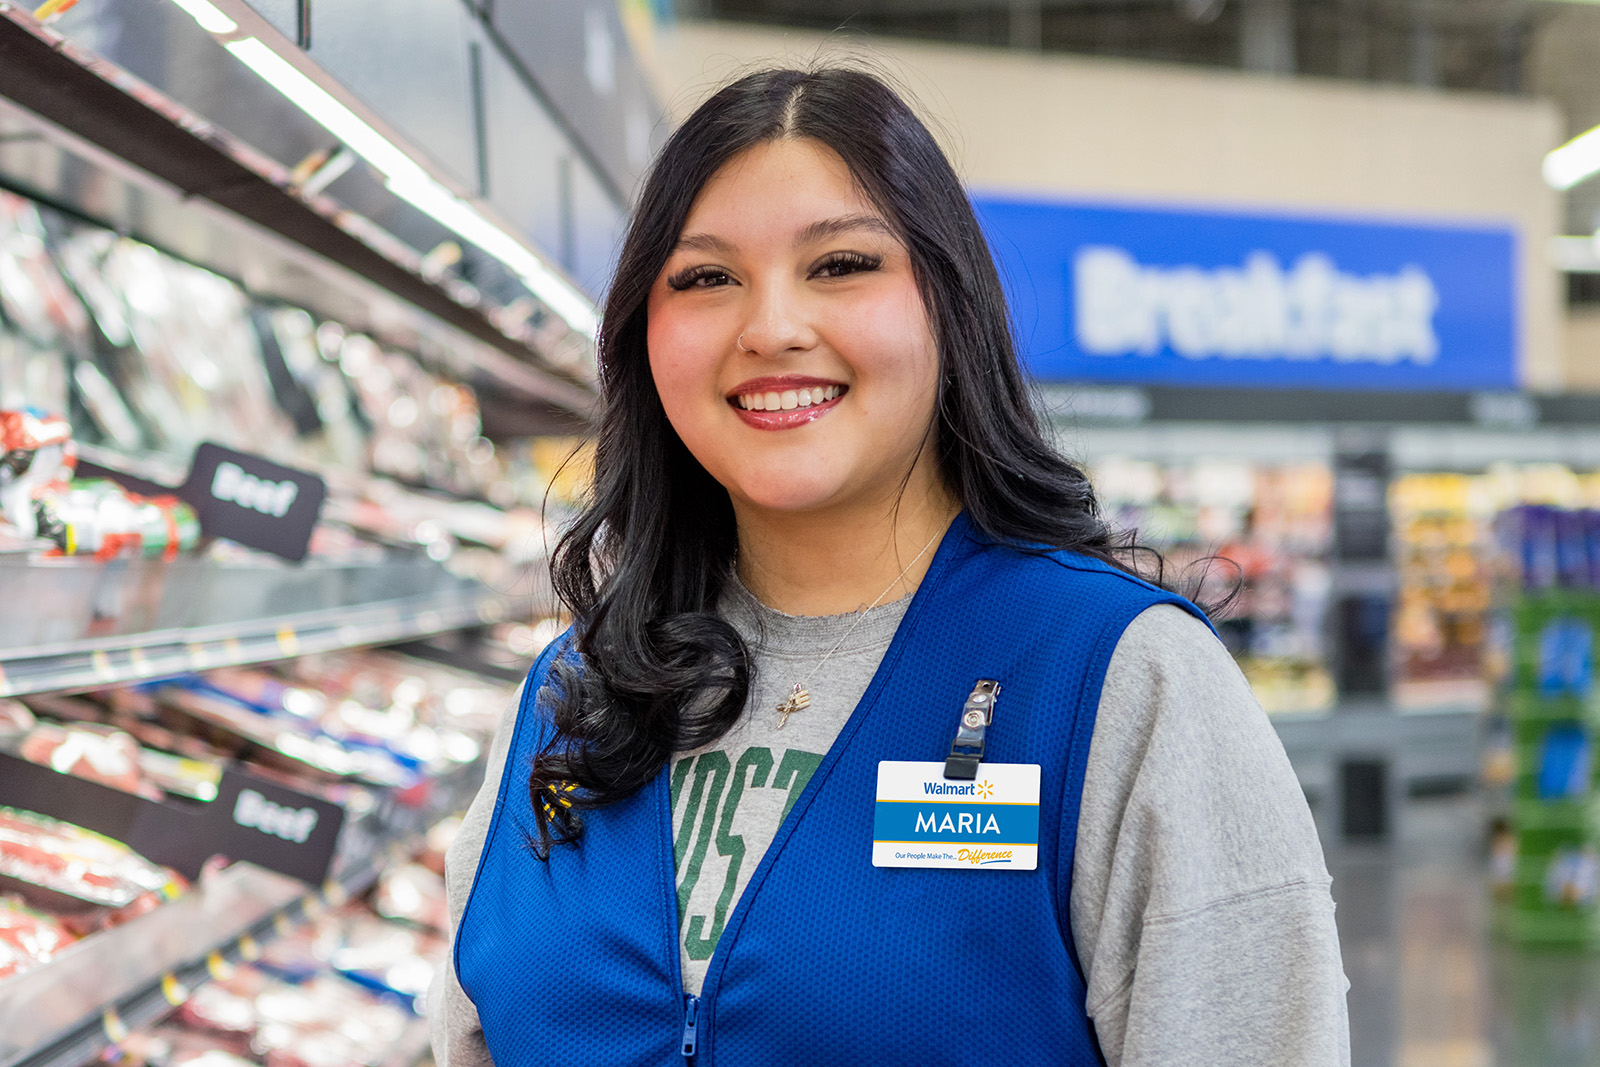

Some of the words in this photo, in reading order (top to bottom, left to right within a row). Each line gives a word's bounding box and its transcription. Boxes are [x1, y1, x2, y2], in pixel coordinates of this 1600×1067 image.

[1075, 245, 1438, 363] Breakfast
[211, 461, 299, 518] Beef
[923, 782, 975, 796] Walmart
[233, 788, 319, 844] Beef
[914, 811, 1001, 834] MARIA
[907, 852, 926, 860] People
[927, 852, 943, 860] Make
[957, 848, 1013, 864] Difference
